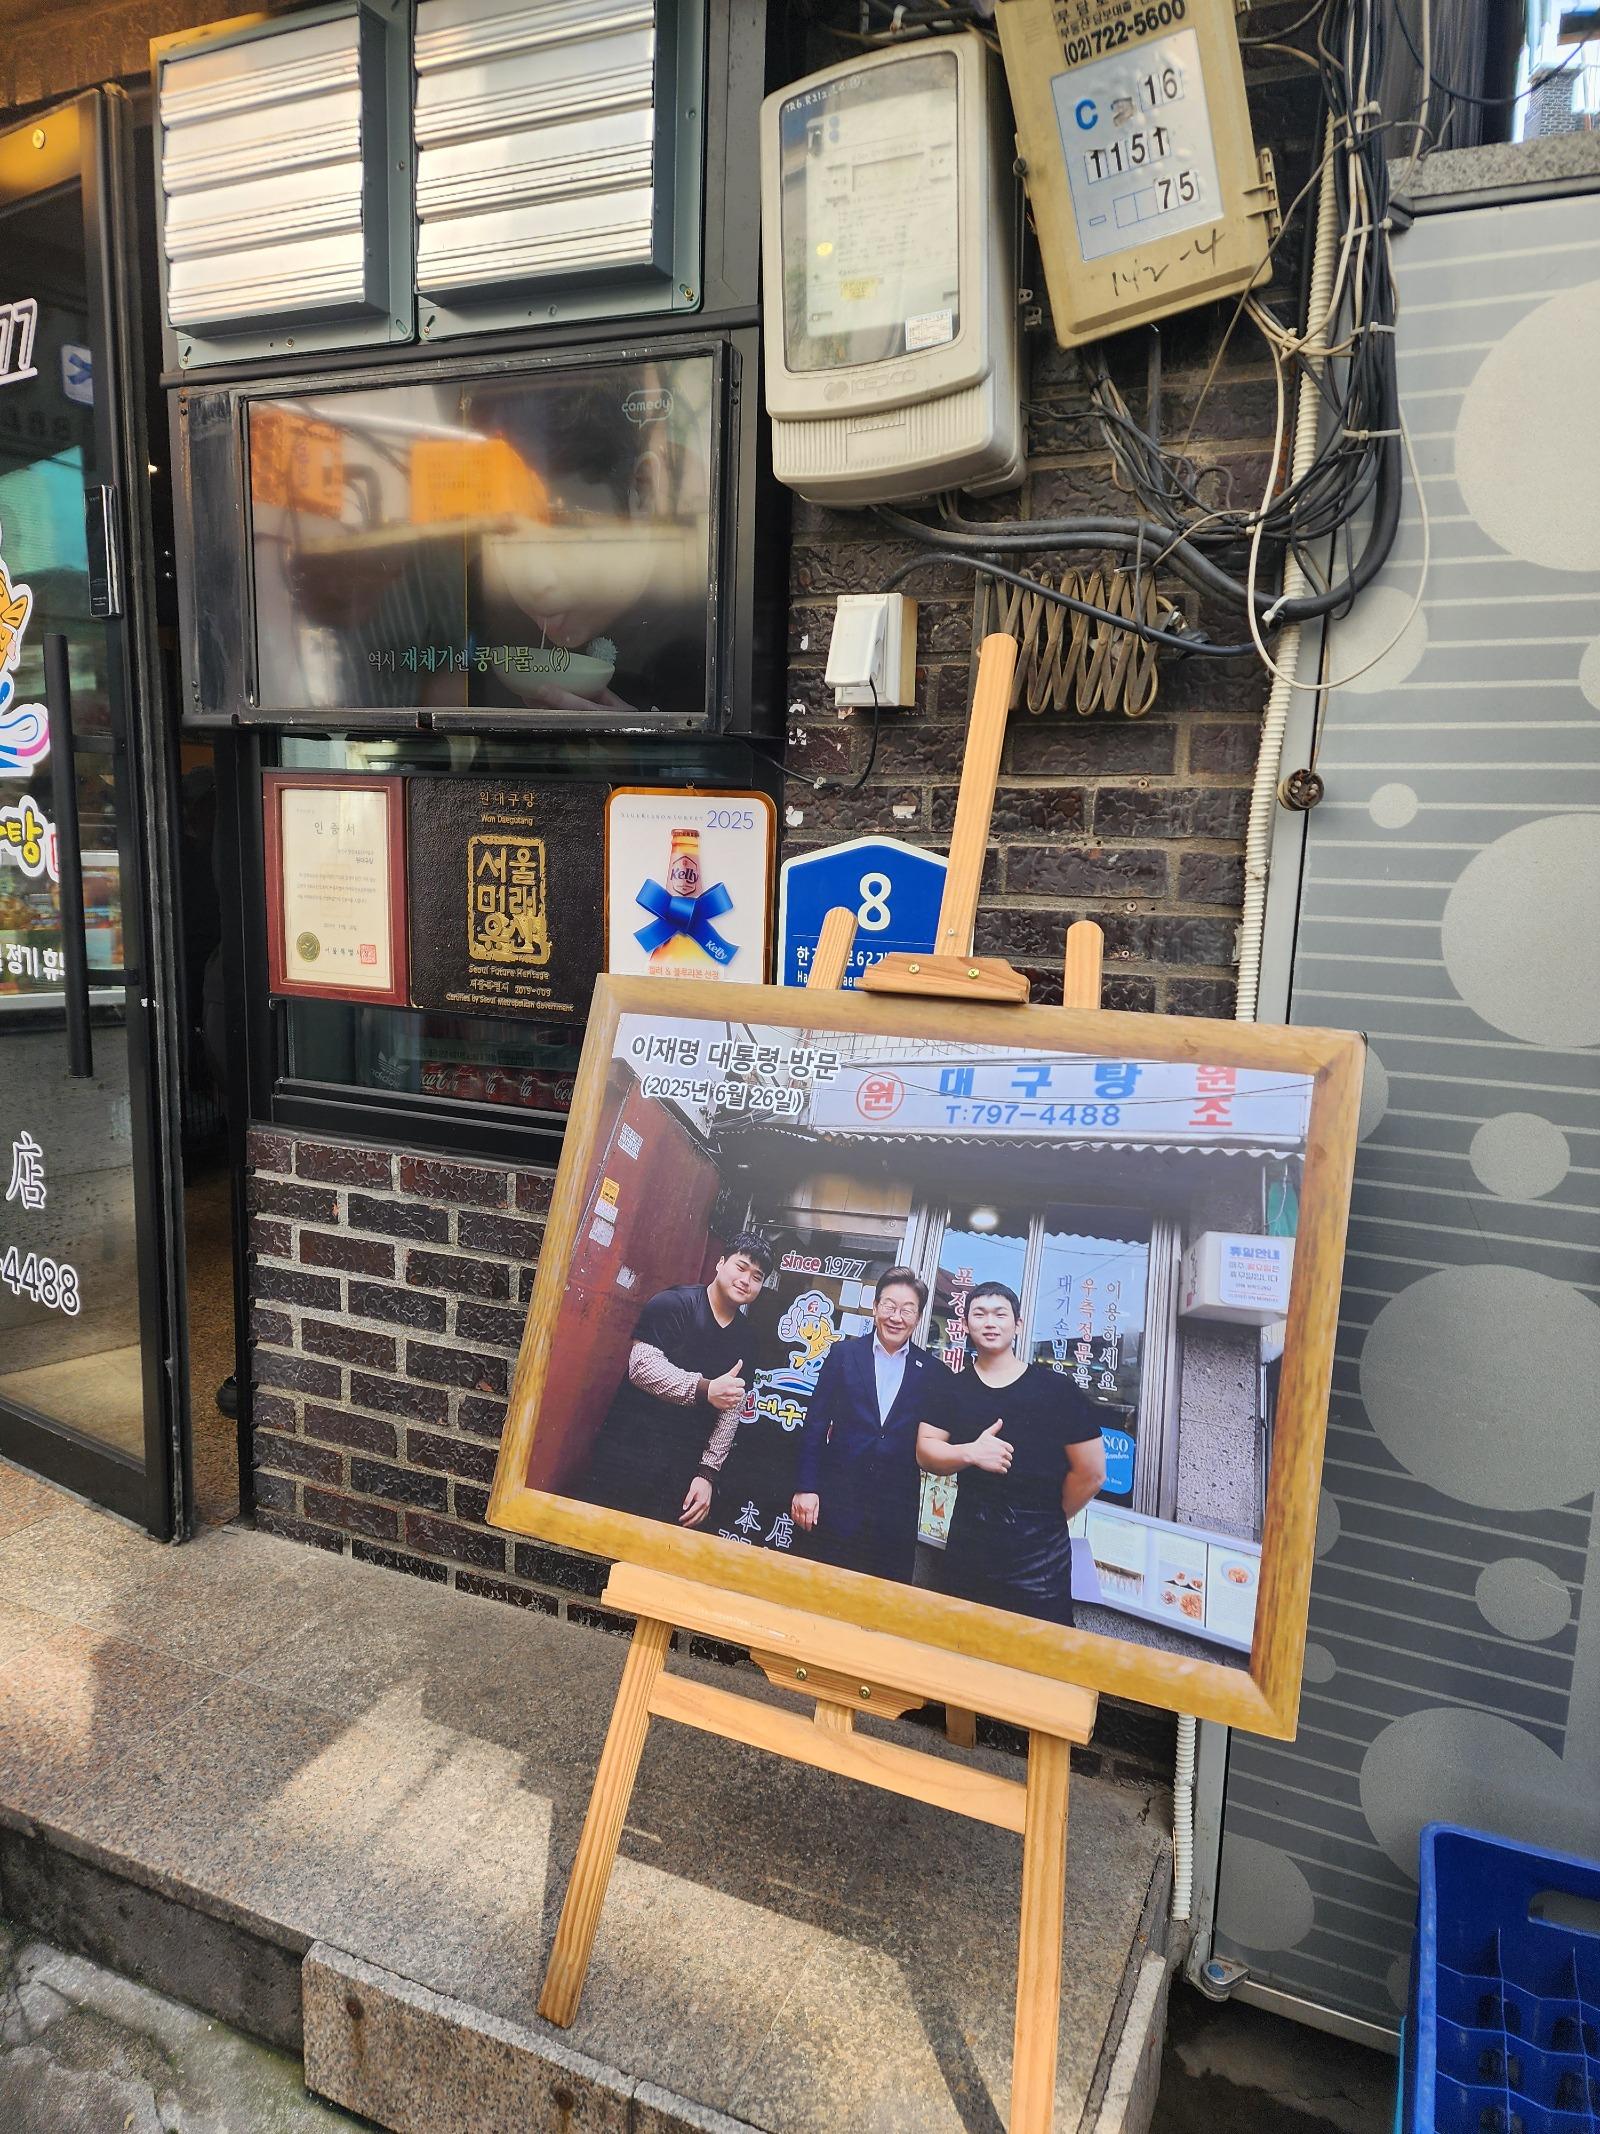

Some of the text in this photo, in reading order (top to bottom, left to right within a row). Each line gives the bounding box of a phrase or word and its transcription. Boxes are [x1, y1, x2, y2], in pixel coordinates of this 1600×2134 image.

[1064, 0, 1185, 66] (02)722-5600
[1075, 100, 1098, 130] C
[1145, 69, 1178, 105] 16
[1090, 127, 1167, 178] 1151
[1158, 171, 1195, 209] 75
[621, 397, 672, 414] comedy
[368, 650, 396, 672] 역시
[706, 809, 755, 831] 2025
[477, 847, 537, 885] 서울
[669, 867, 701, 886] Kelly
[477, 886, 537, 915] 미래
[858, 872, 892, 931] 8
[705, 939, 729, 961] Kelly
[632, 1036, 839, 1080] 이재명 대통령 방문
[641, 1075, 804, 1113] (2025년 6월 26일)
[5, 1131, 47, 1210] 店
[0, 1246, 80, 1316] 4488
[781, 1251, 867, 1279] since 1977
[1072, 1278, 1098, 1389] 우측정문을
[1097, 1280, 1122, 1391] 이용하세요
[1102, 1434, 1128, 1452] SCO
